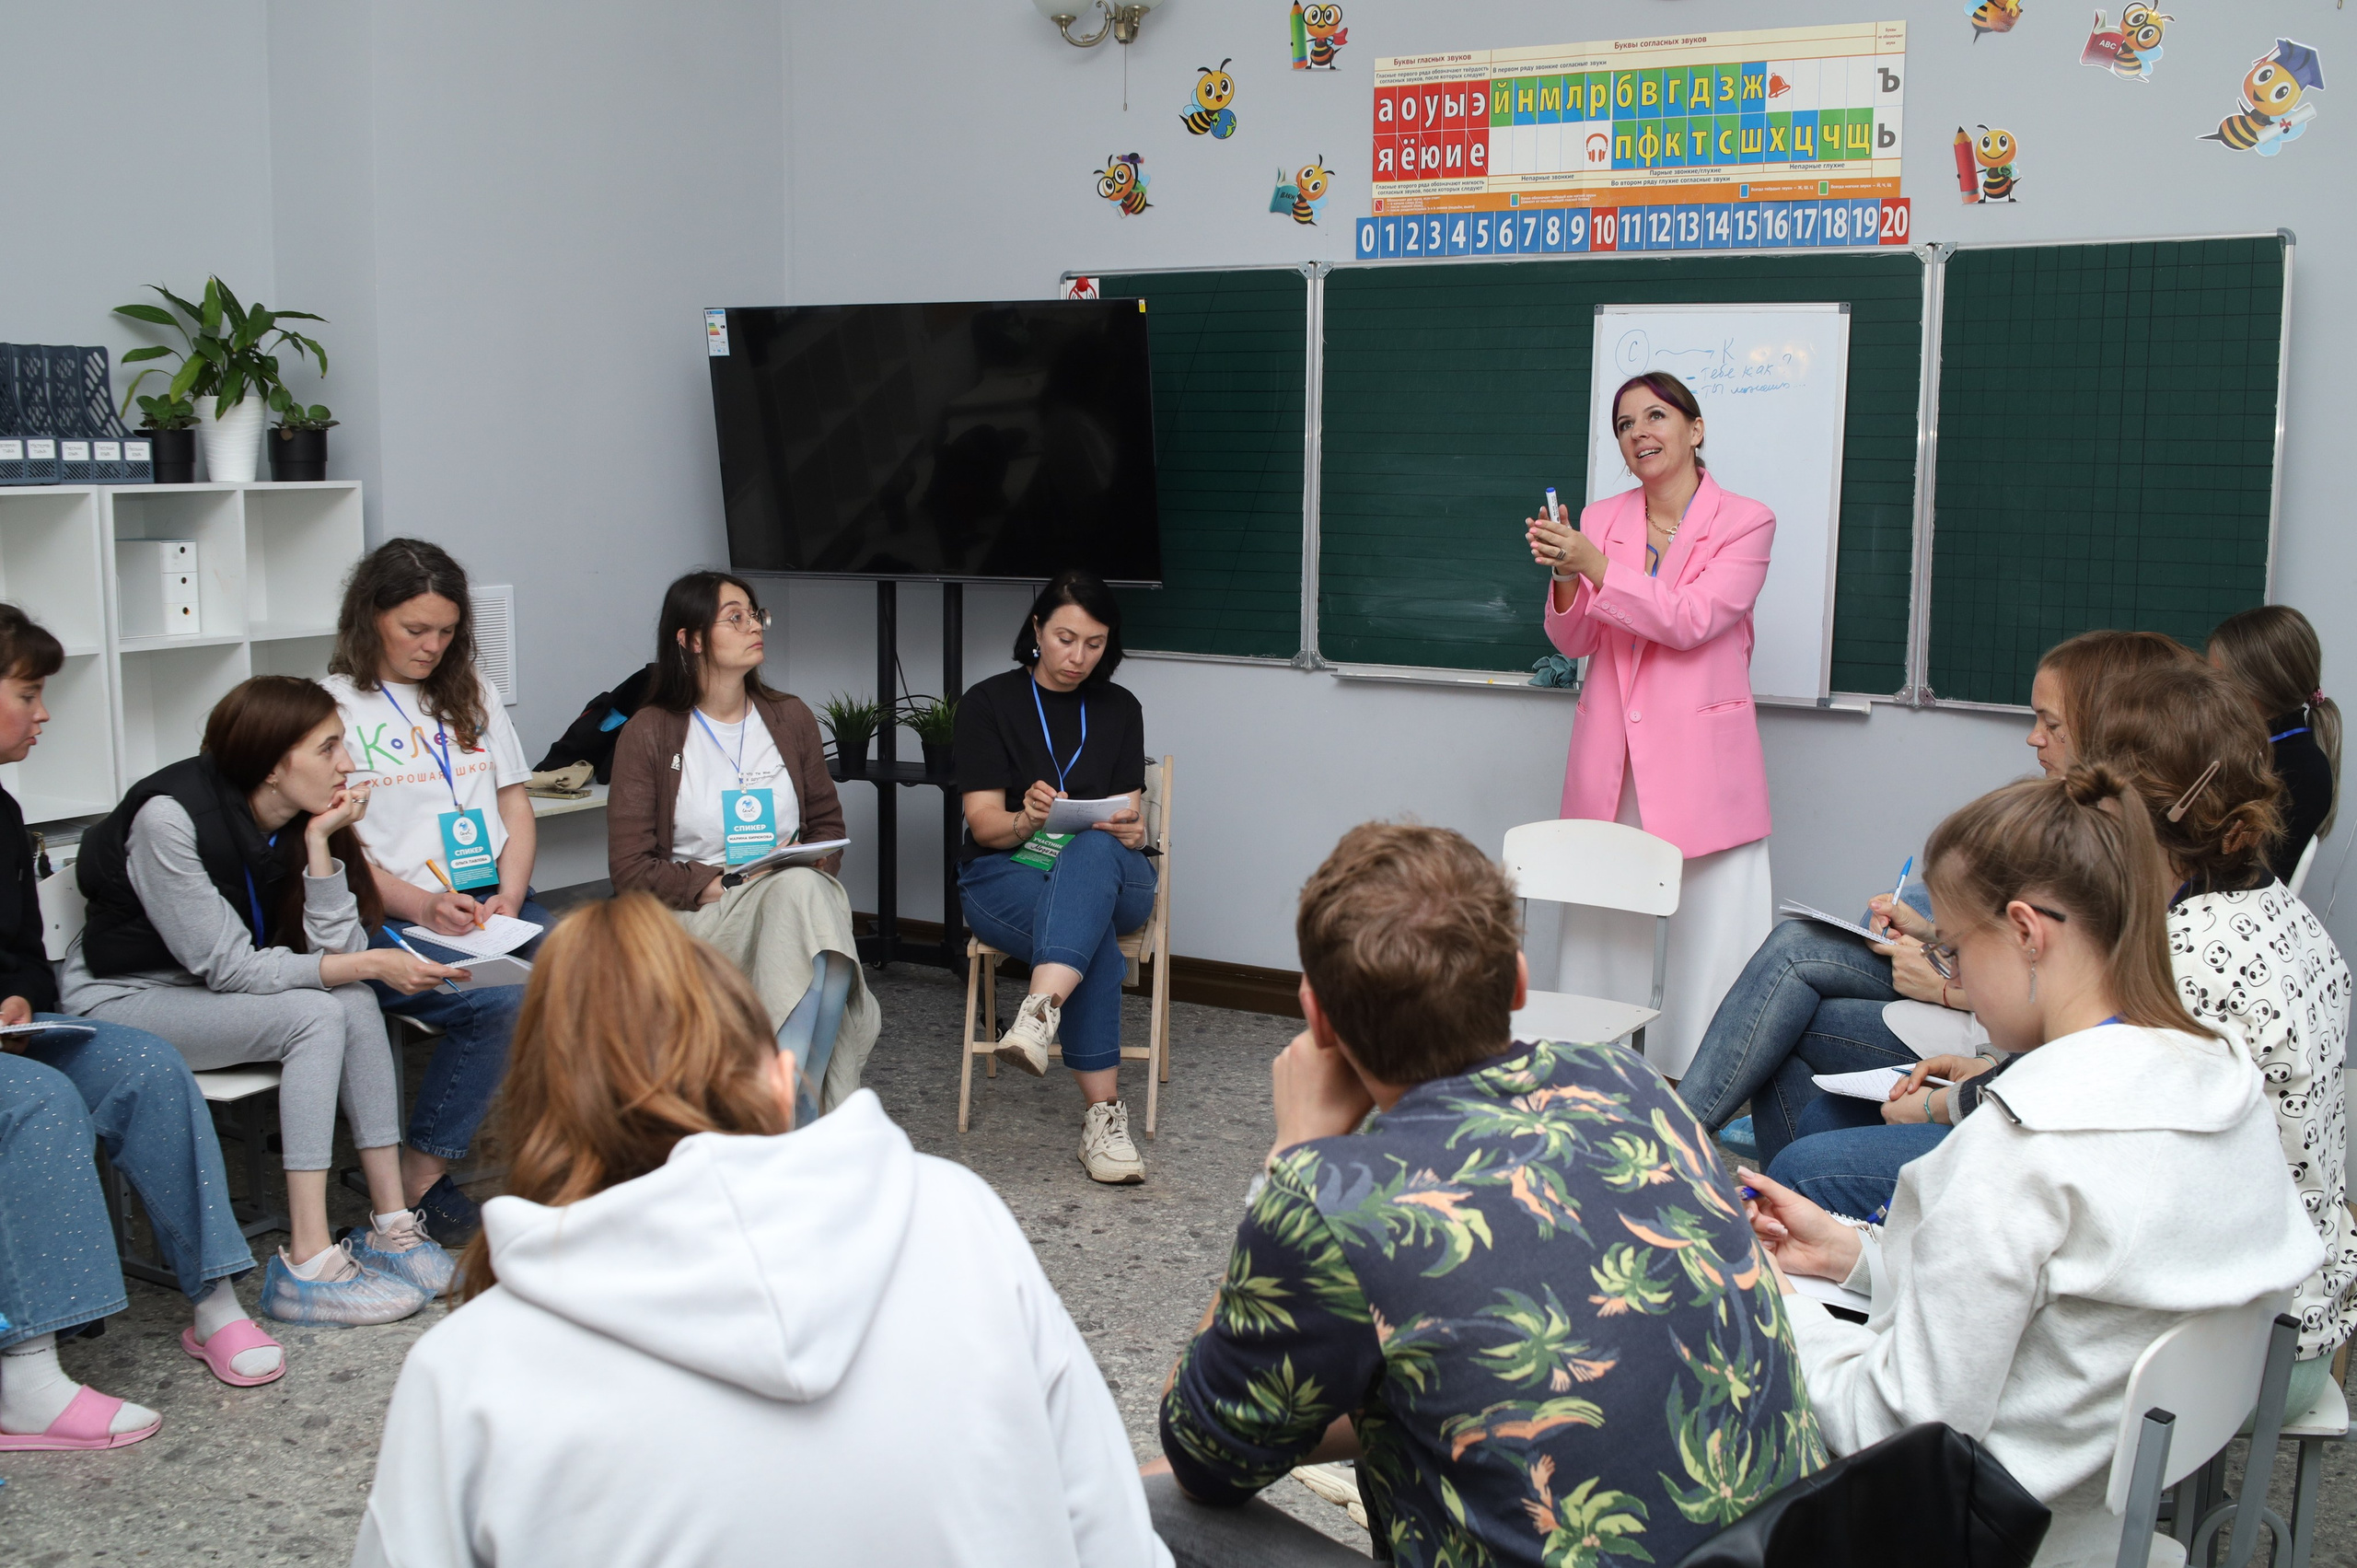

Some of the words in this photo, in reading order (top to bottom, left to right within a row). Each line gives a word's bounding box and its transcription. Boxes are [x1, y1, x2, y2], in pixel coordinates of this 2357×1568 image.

[1614, 41, 1638, 51] Буквы
[1640, 39, 1678, 48] согласных
[1681, 37, 1707, 45] звуков
[2099, 40, 2117, 50] ABC
[1394, 58, 1415, 67] Буквы
[1418, 55, 1445, 64] гласных
[1447, 54, 1471, 63] звуков
[1560, 61, 1588, 69] согласные
[1398, 70, 1418, 78] первого
[1494, 81, 1510, 114] й
[1517, 88, 1534, 113] н
[1539, 87, 1561, 112] м
[1566, 85, 1583, 110] л
[1589, 83, 1607, 118] р
[1616, 73, 1633, 108] б
[1641, 81, 1658, 106] в
[1668, 79, 1681, 104] г
[1689, 77, 1711, 110] д
[1718, 75, 1735, 101] з
[1742, 74, 1765, 100] ж
[1378, 98, 1393, 122] а
[1401, 97, 1417, 121] о
[1424, 95, 1439, 128] у
[1445, 93, 1466, 118] ы
[1471, 92, 1486, 117] э
[1615, 134, 1632, 159] п
[1638, 125, 1659, 167] ф
[1665, 132, 1681, 157] к
[1691, 131, 1707, 156] т
[1718, 129, 1733, 155] с
[1740, 128, 1762, 154] ш
[1769, 126, 1787, 153] х
[1794, 125, 1814, 157] ц
[1822, 124, 1840, 150] ч
[1846, 122, 1870, 156] щ
[1377, 148, 1393, 171] я
[1401, 138, 1416, 170] ё
[1421, 145, 1440, 169] ю
[1446, 144, 1462, 168] и
[1470, 143, 1485, 167] е
[1789, 163, 1821, 171] Непарные
[1361, 224, 1375, 252] 0
[1385, 224, 1395, 251] 1
[1407, 222, 1419, 250] 2
[1429, 221, 1441, 250] 3
[1451, 220, 1466, 249] 4
[1476, 219, 1489, 248] 5
[1499, 218, 1513, 248] 6
[1523, 217, 1536, 246] 7
[1546, 216, 1560, 246] 8
[1571, 215, 1585, 246] 9
[1593, 215, 1615, 245] 10
[1620, 214, 1642, 244] 11
[1648, 213, 1671, 243] 12
[1677, 212, 1700, 241] 13
[1705, 211, 1730, 240] 14
[1735, 210, 1758, 240] 15
[1763, 209, 1788, 239] 16
[1793, 208, 1817, 238] 17
[1822, 207, 1848, 238] 18
[1852, 206, 1877, 238] 19
[1880, 205, 1908, 238] 20
[371, 772, 446, 788] ХОРОШАЯ
[456, 761, 496, 777] ШКОЛ
[734, 824, 766, 832] СПИКЕР
[1033, 837, 1063, 850] УЧАСТНИК
[454, 846, 483, 856] СПИКЕР
